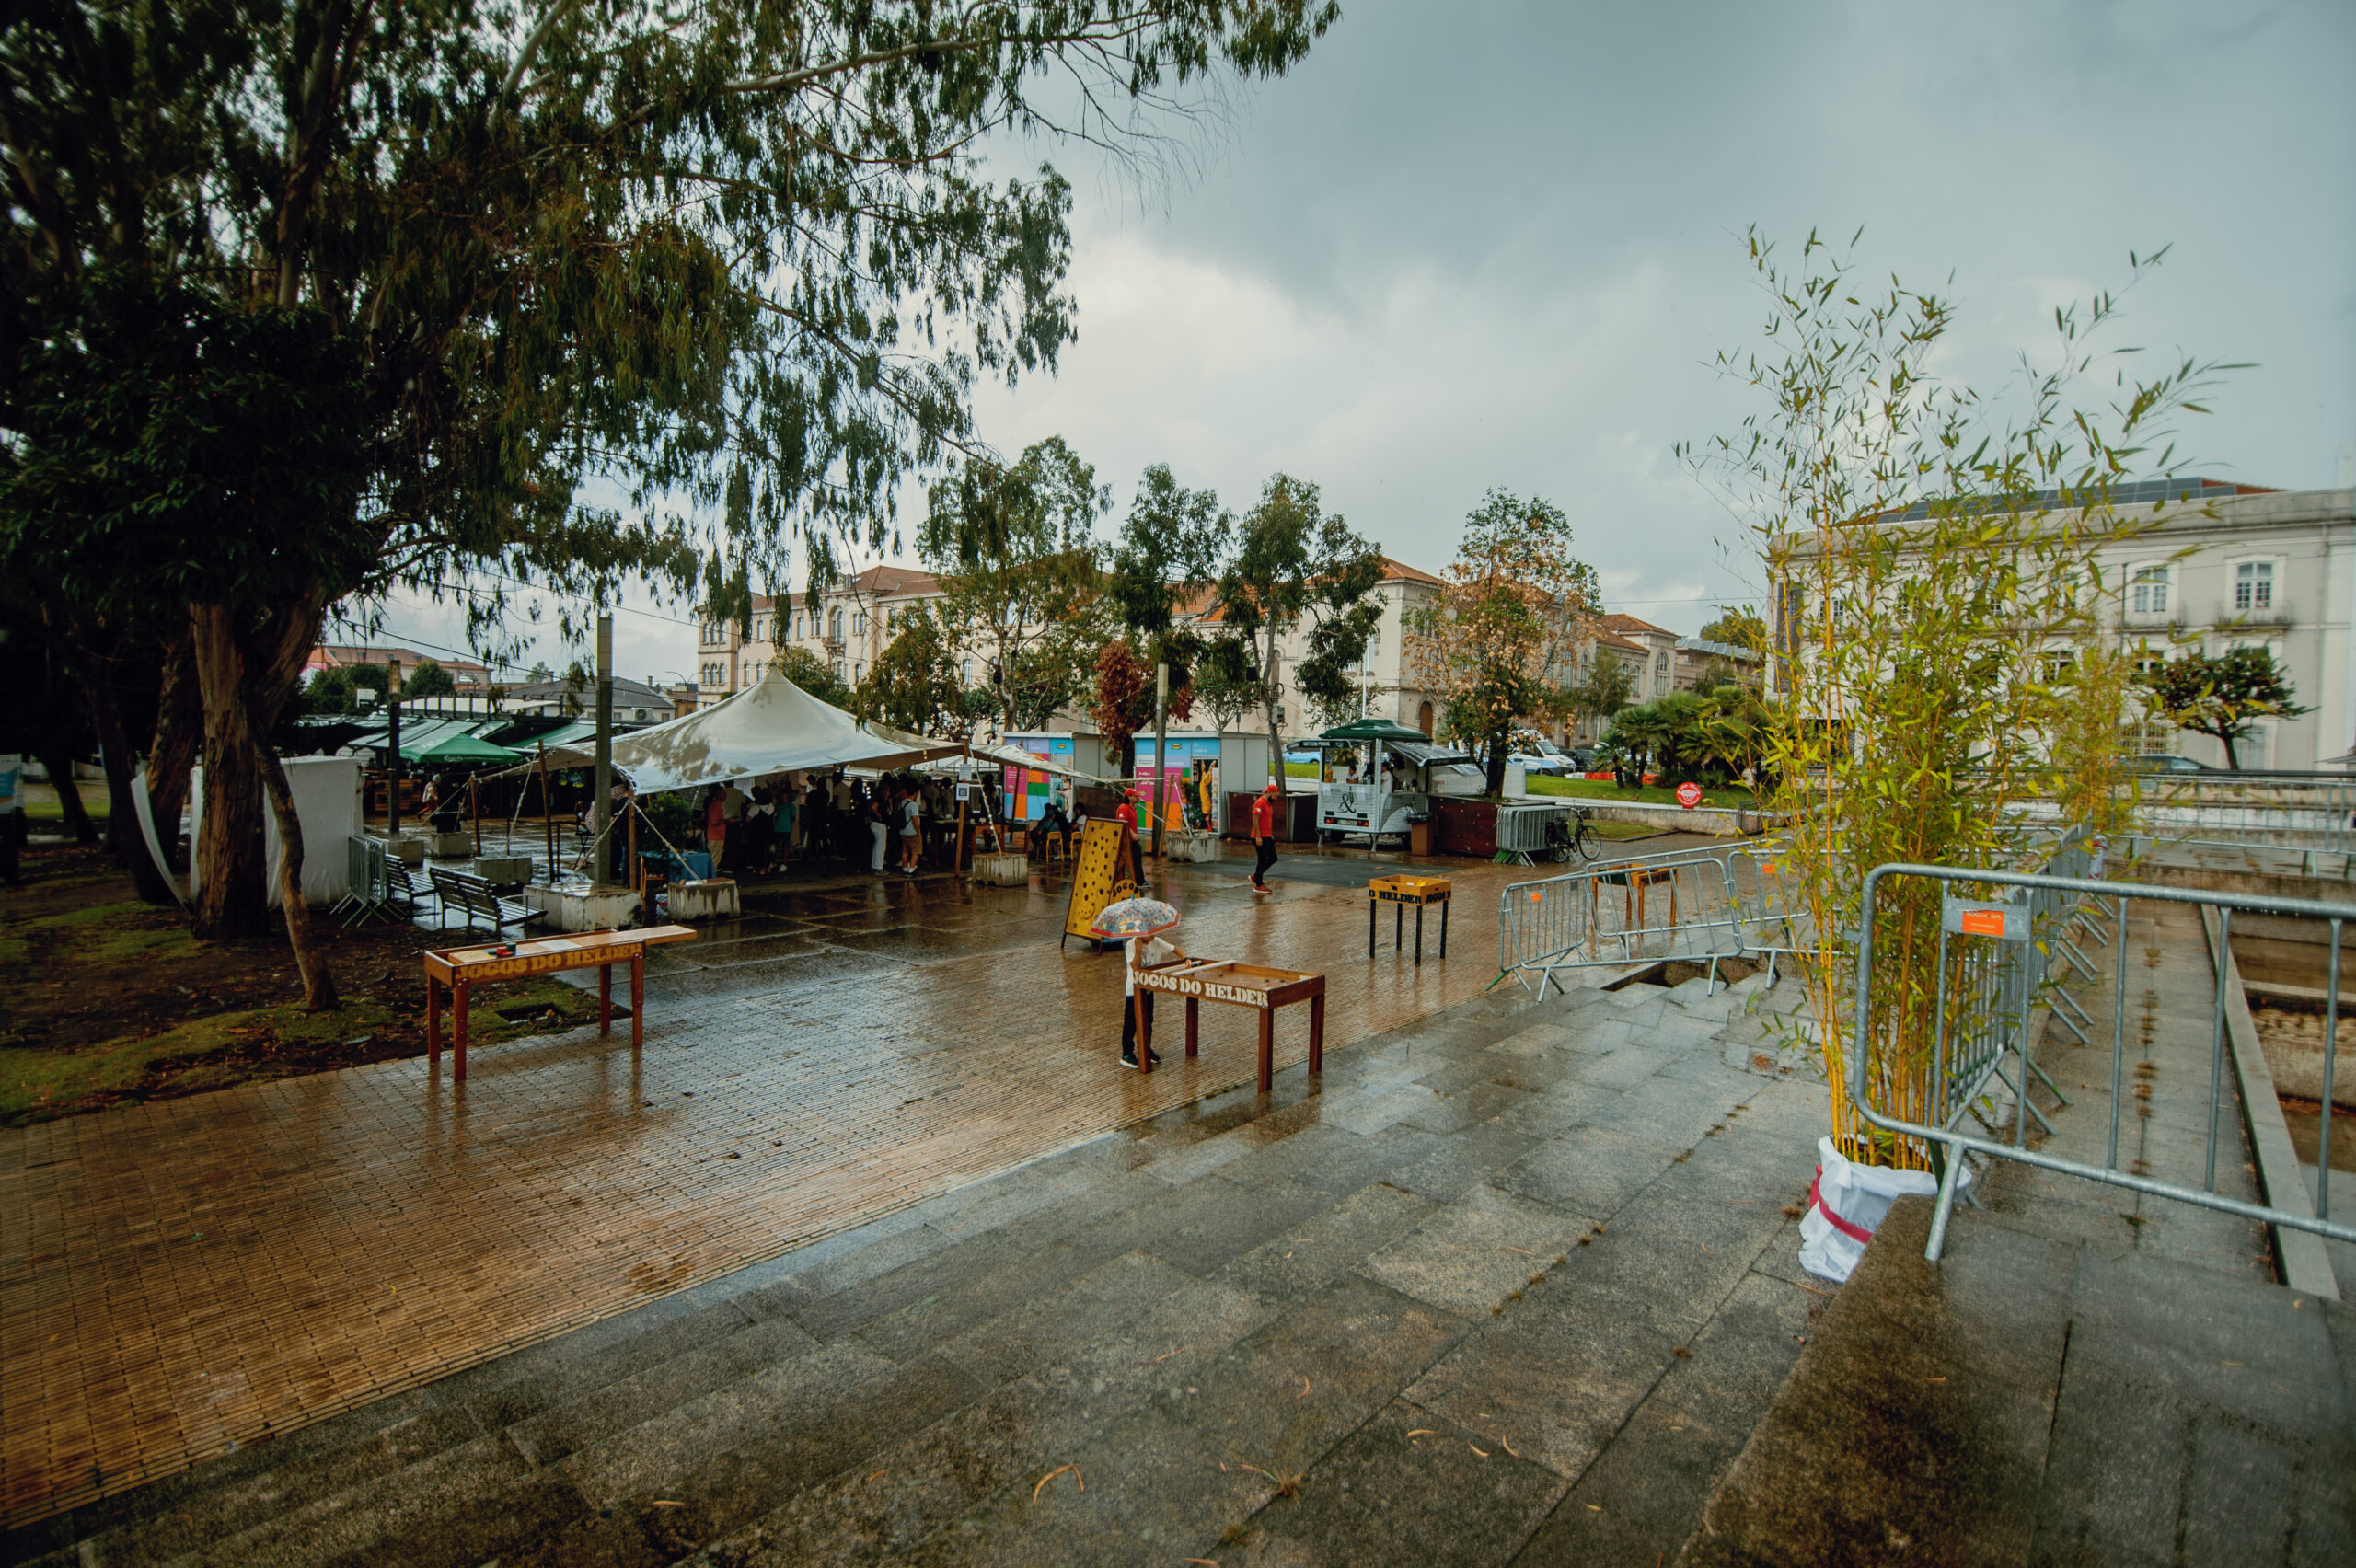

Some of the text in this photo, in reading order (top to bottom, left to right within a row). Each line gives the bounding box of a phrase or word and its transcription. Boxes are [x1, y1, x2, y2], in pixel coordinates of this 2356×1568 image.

[1379, 891, 1421, 904] HELDER
[456, 943, 643, 978] JOGOS DO HELDER
[1133, 971, 1268, 1008] JOGOS DO HELDER
